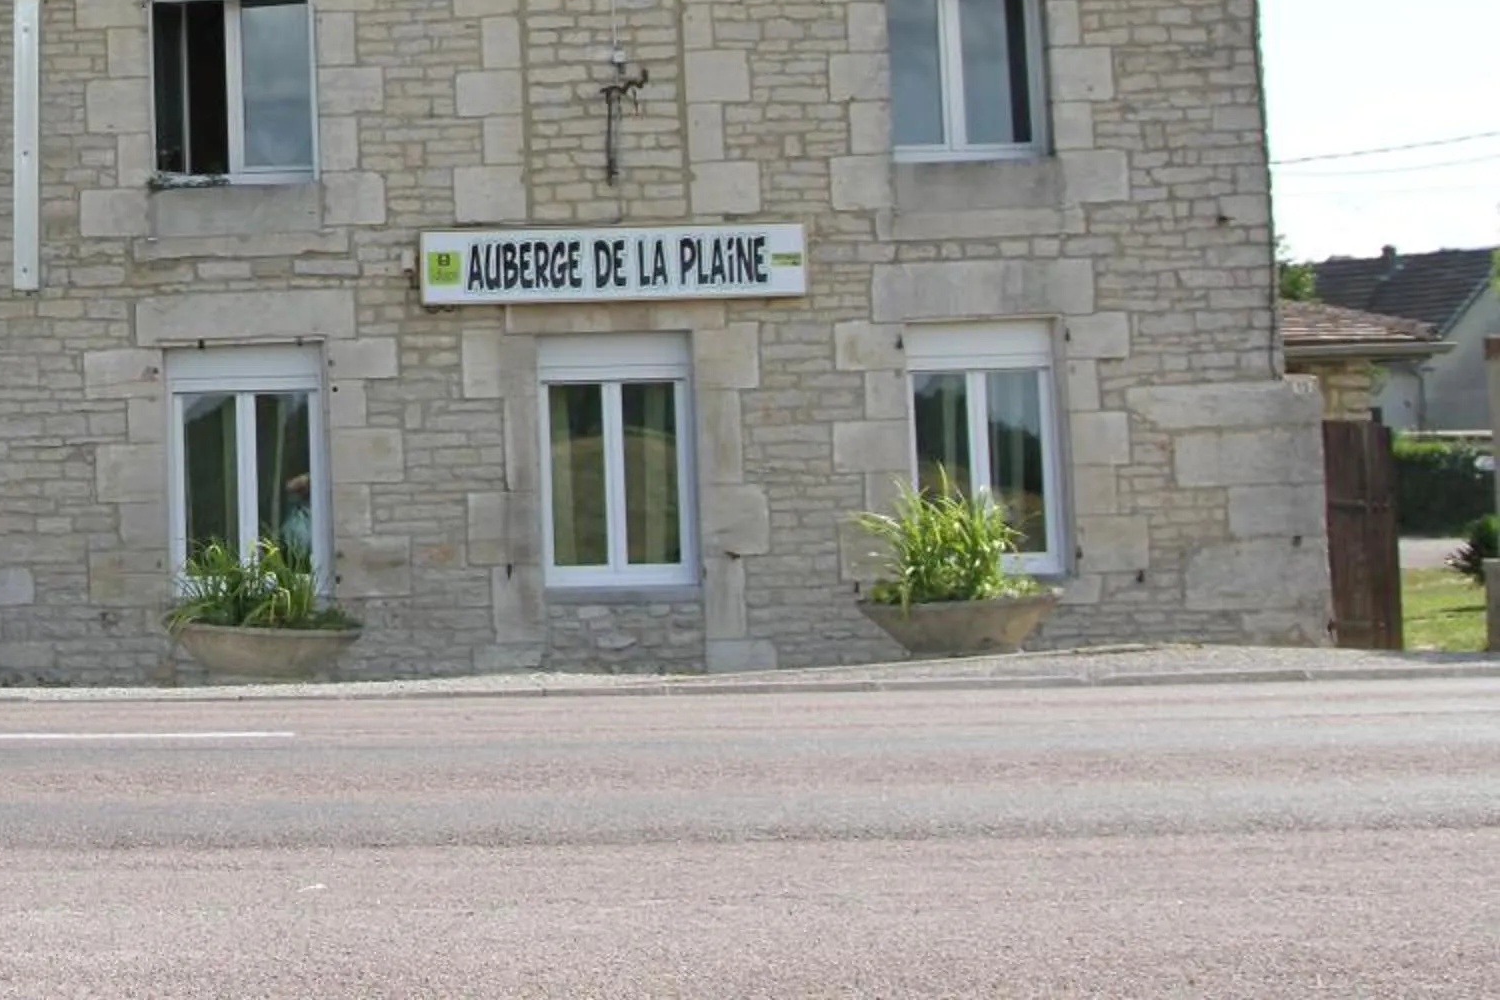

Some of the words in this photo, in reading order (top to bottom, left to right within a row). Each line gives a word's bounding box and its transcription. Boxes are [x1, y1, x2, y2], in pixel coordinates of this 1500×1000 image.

[467, 239, 582, 290] AUBERGE
[595, 239, 627, 287] DE
[638, 238, 668, 286] LA
